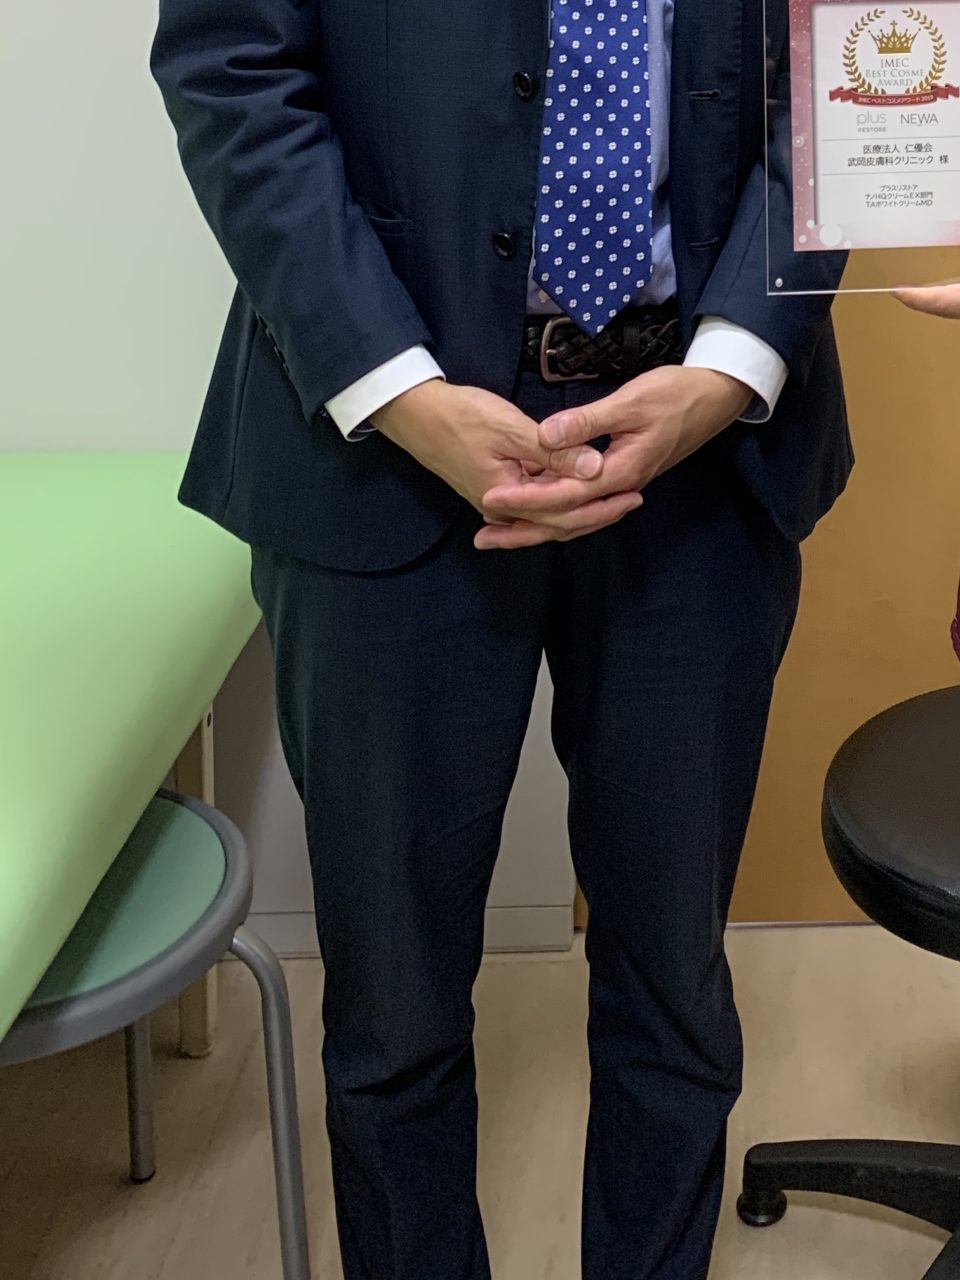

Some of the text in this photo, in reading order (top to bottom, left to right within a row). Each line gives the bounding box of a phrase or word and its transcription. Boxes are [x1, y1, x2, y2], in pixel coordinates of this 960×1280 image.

[879, 58, 910, 69] JMEC
[865, 68, 925, 79] BEST COSME
[877, 78, 914, 87] AWARD
[856, 110, 939, 126] plus NEWA
[863, 144, 900, 154] 医療法人
[848, 155, 934, 167] 武岡皮膚科クリニック
